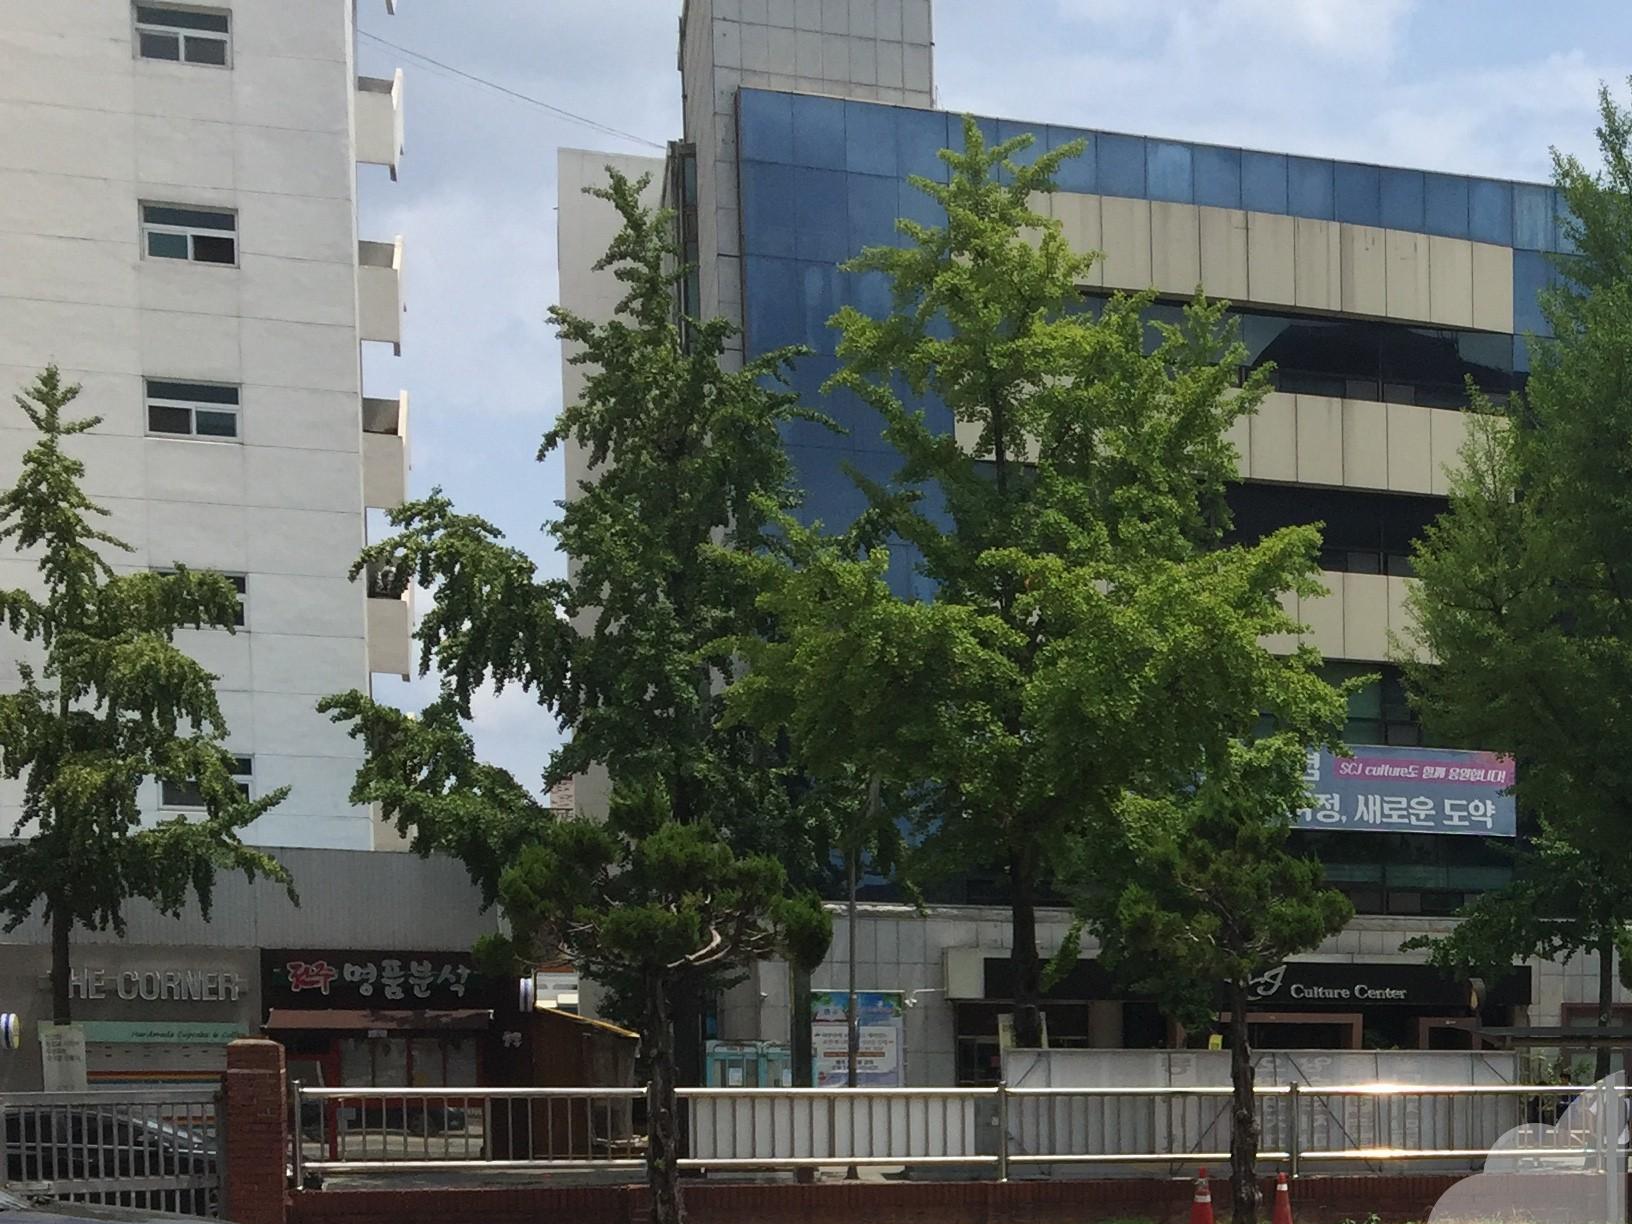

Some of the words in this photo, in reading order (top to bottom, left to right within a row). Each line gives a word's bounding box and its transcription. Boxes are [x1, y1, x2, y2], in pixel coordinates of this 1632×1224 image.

[1339, 762, 1362, 776] SCJ
[1365, 764, 1419, 778] culture도
[1422, 766, 1447, 780] 함께
[1354, 794, 1436, 826] 새로운
[1443, 798, 1496, 829] 도약
[48, 967, 106, 999] HE
[116, 969, 239, 1000] CORNER
[343, 959, 472, 999] 명품분석
[1290, 984, 1350, 999] Culture
[1354, 984, 1407, 999] Center
